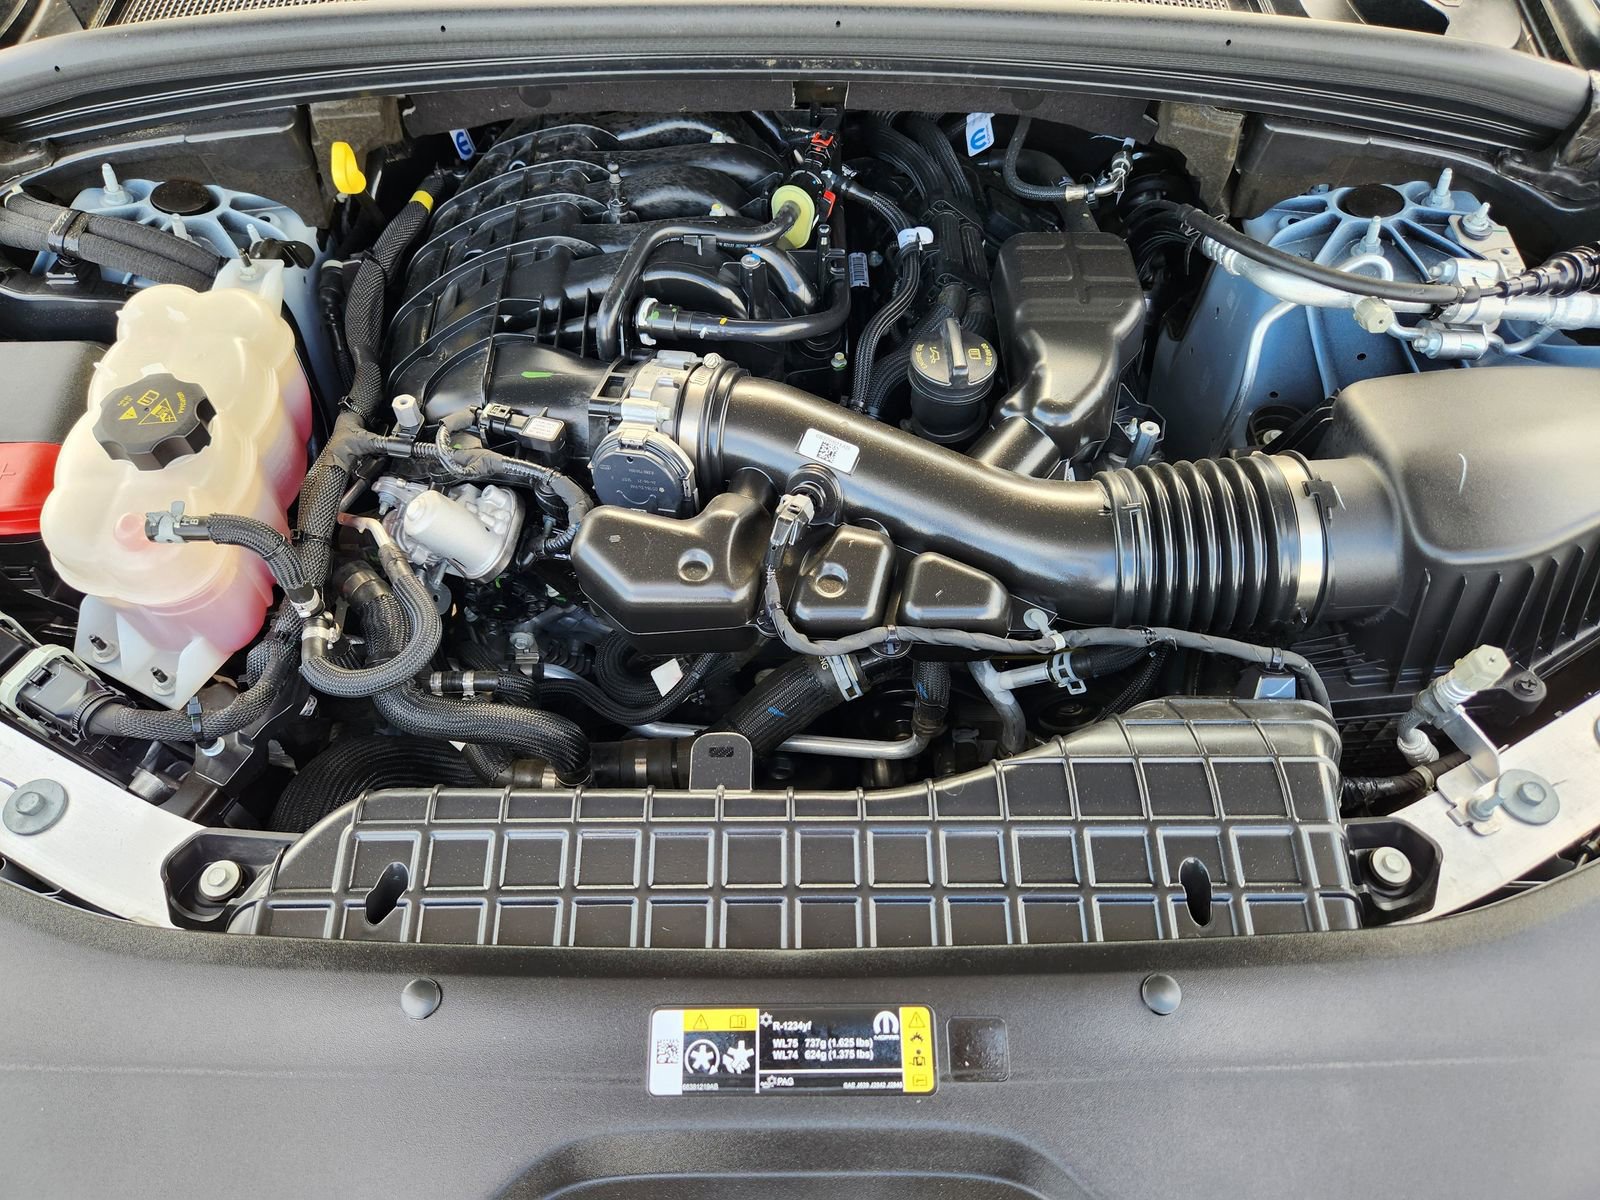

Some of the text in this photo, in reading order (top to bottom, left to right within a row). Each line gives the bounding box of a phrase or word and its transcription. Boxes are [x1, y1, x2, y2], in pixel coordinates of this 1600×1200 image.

[772, 1021, 812, 1033] R-1234yf
[772, 1037, 873, 1050] WL75 737g (1.625 lbs)
[772, 1049, 874, 1062] WL74 624g (1.375 lbs)
[776, 1077, 794, 1087] PAG
